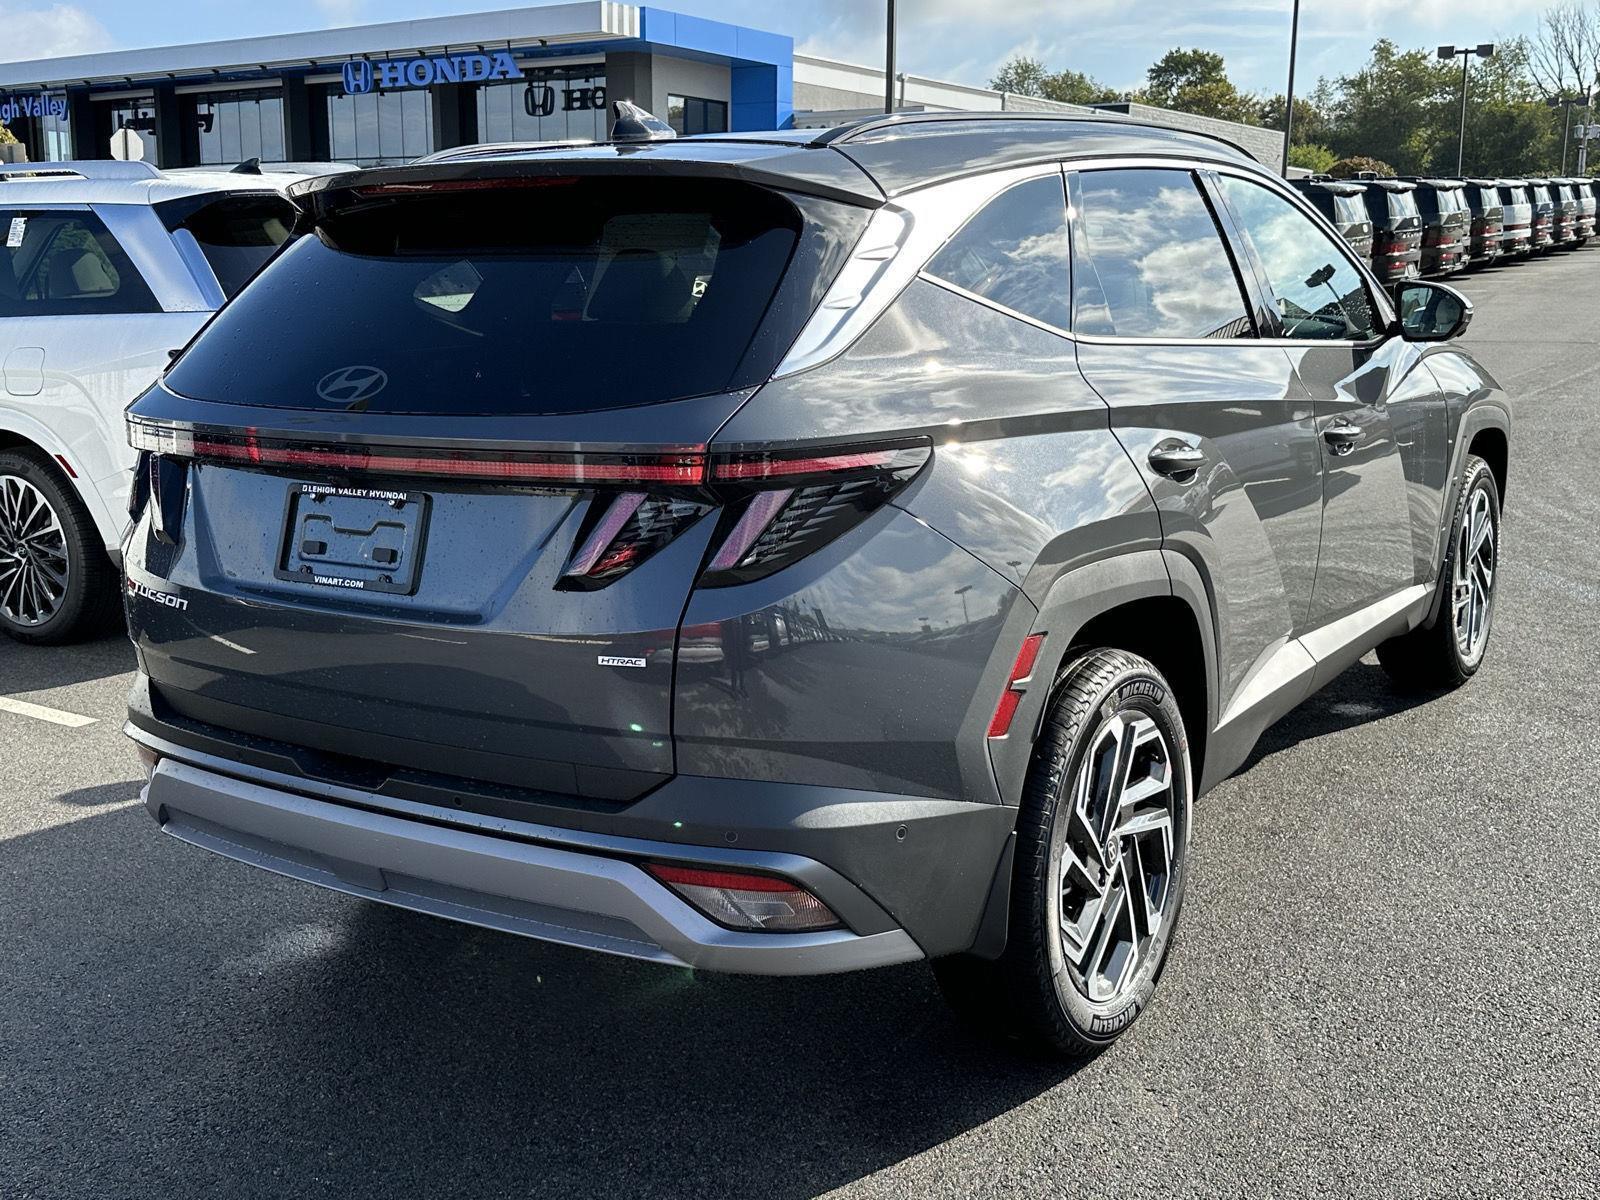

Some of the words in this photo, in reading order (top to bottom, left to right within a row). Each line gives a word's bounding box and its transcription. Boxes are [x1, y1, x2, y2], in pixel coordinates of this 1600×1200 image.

[379, 53, 525, 88] HONDA
[0, 97, 20, 124] gh
[22, 95, 67, 121] Valley
[308, 485, 336, 494] LEHIGH
[338, 488, 367, 496] VALLEY
[369, 490, 407, 500] HYUNDAI
[314, 576, 364, 588] VINART.COM
[1121, 682, 1164, 702] MICHELIN
[1093, 1003, 1137, 1032] MICHELIN
